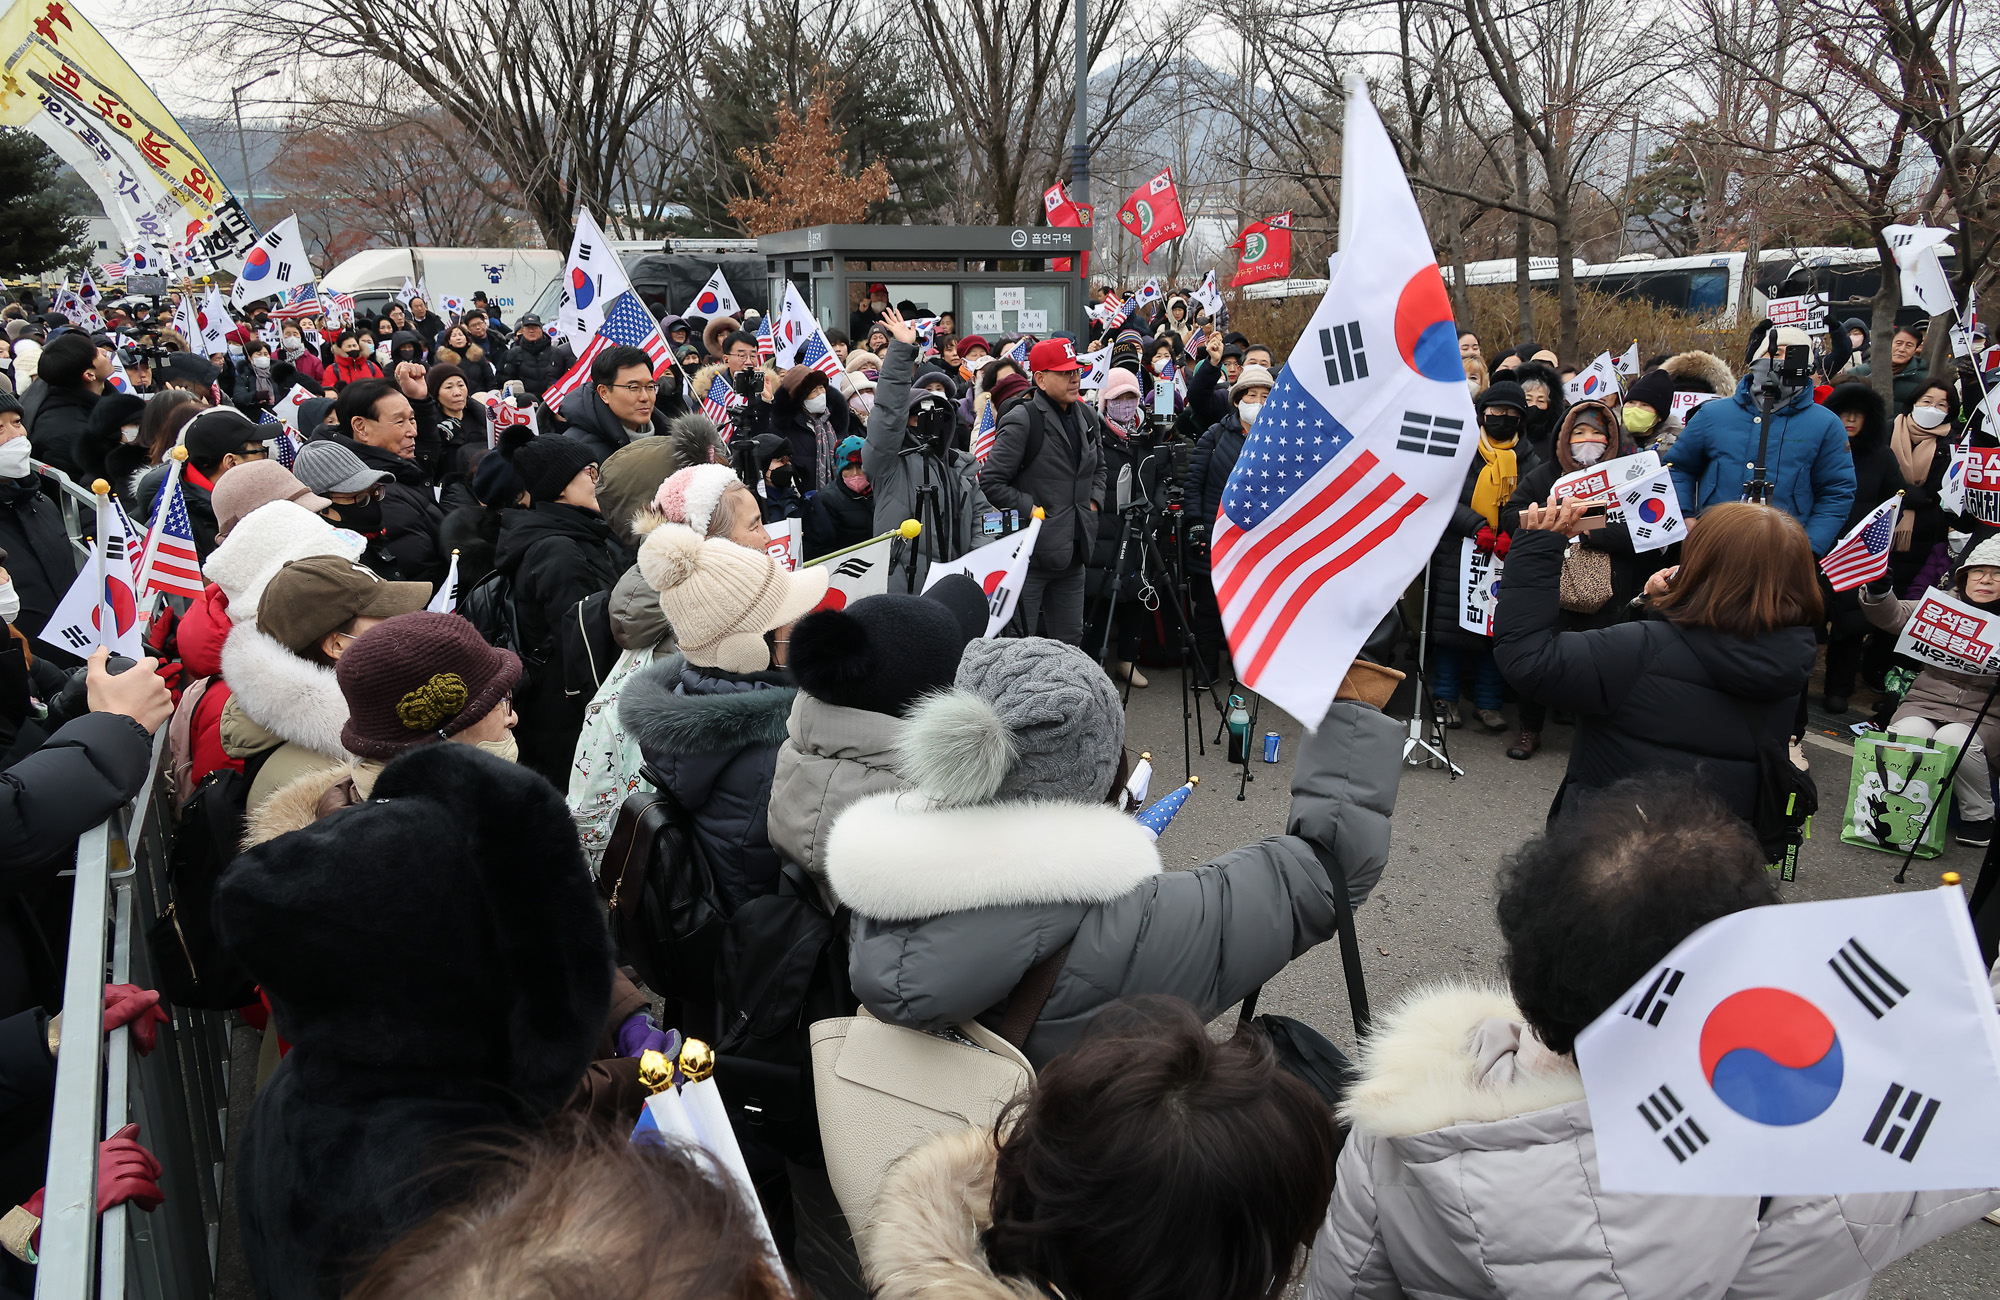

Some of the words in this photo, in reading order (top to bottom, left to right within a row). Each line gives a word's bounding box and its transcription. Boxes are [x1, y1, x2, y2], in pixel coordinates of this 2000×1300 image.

[1031, 232, 1072, 245] 흡연구역
[1767, 285, 1778, 299] 19
[1921, 602, 1980, 638] 윤석열
[1913, 620, 1987, 662] 대통령과
[1890, 762, 1903, 770] my
[1906, 765, 1936, 773] pnet!
